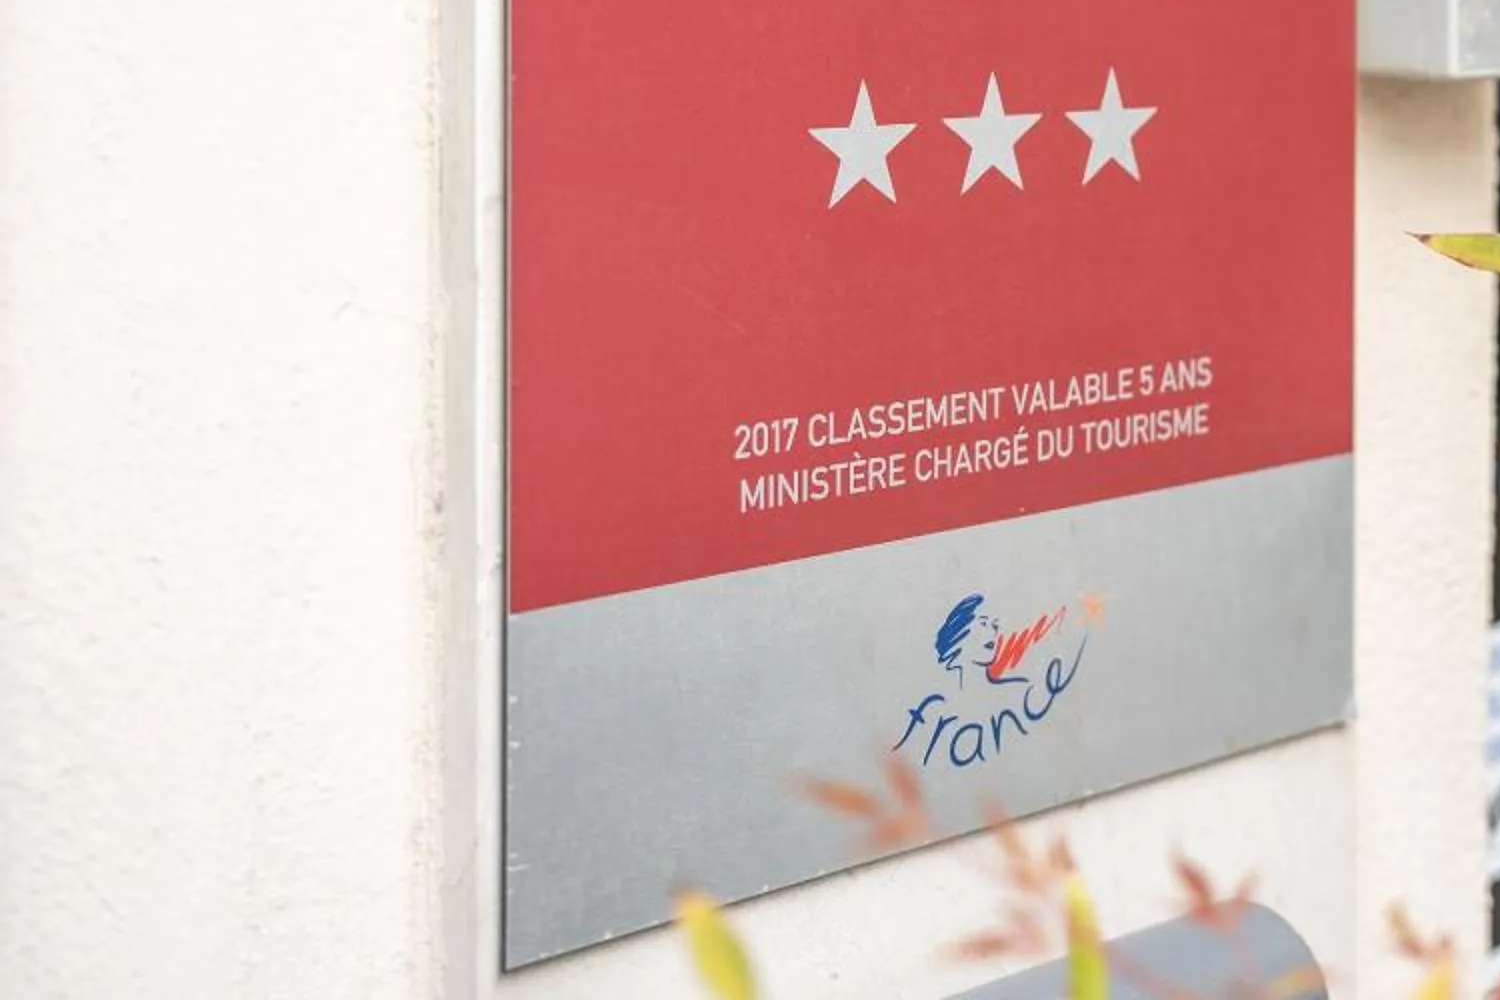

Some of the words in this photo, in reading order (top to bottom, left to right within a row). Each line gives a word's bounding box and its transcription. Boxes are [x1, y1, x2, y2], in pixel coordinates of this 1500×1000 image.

[734, 418, 799, 459] 2017
[807, 388, 1005, 447] CLASSEMENT
[1011, 368, 1135, 415] VALABLE
[1139, 366, 1154, 396] 5
[1159, 357, 1213, 393] ANS
[739, 455, 906, 512] MINISTÈRE
[914, 432, 1030, 482] CHARGÉ
[1037, 427, 1075, 463] DU
[1080, 403, 1210, 454] TOURISME
[892, 632, 1088, 767] france
